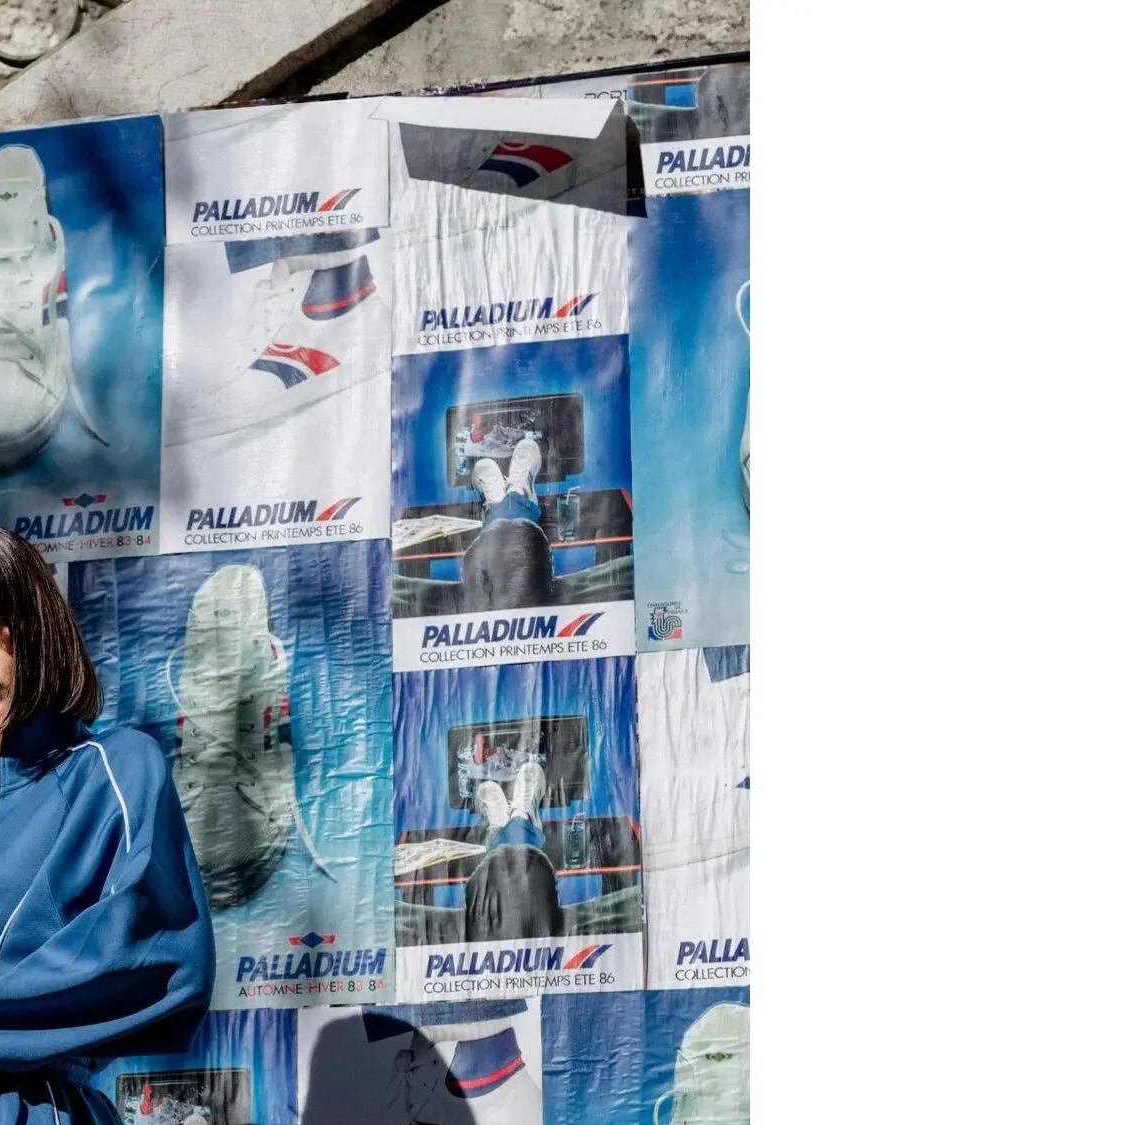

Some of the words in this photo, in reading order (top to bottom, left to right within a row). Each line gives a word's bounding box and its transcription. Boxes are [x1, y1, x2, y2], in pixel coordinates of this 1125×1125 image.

[654, 173, 731, 189] COLLECTION
[192, 191, 320, 223] PALLADIUM
[191, 222, 262, 237] COLLECTION
[266, 216, 324, 231] PRINTEMPS
[328, 214, 346, 226] ETE
[350, 212, 363, 224] 86
[420, 297, 554, 332] PALLADIUM
[418, 330, 491, 346] COLLECTION
[498, 322, 560, 338] PRINTEMPS
[563, 320, 584, 333] ETE
[15, 506, 155, 540] PALLADIUM
[186, 500, 318, 531] PALLADIUM
[35, 540, 75, 554] OMNE
[80, 537, 114, 549] HIVER
[184, 531, 257, 545] COLLECTION
[261, 525, 323, 541] PRINTEMPS
[326, 524, 346, 536] ETE
[349, 522, 363, 534] 86
[421, 615, 558, 649] PALLADIUM
[419, 648, 495, 663] COLLECTION
[500, 641, 565, 657] PRINTEMPS
[567, 640, 589, 653] ETE
[592, 639, 608, 651] 86
[236, 948, 387, 982] PALLADIUM
[425, 946, 565, 979] PALLADIUM
[676, 937, 750, 966] PALLA
[238, 983, 303, 997] AUTOMNE
[308, 980, 344, 994] HIVER
[423, 977, 501, 994] COLLECTION
[506, 974, 571, 989] PRINTEMPS
[574, 973, 596, 986] ETE
[599, 972, 615, 984] 86
